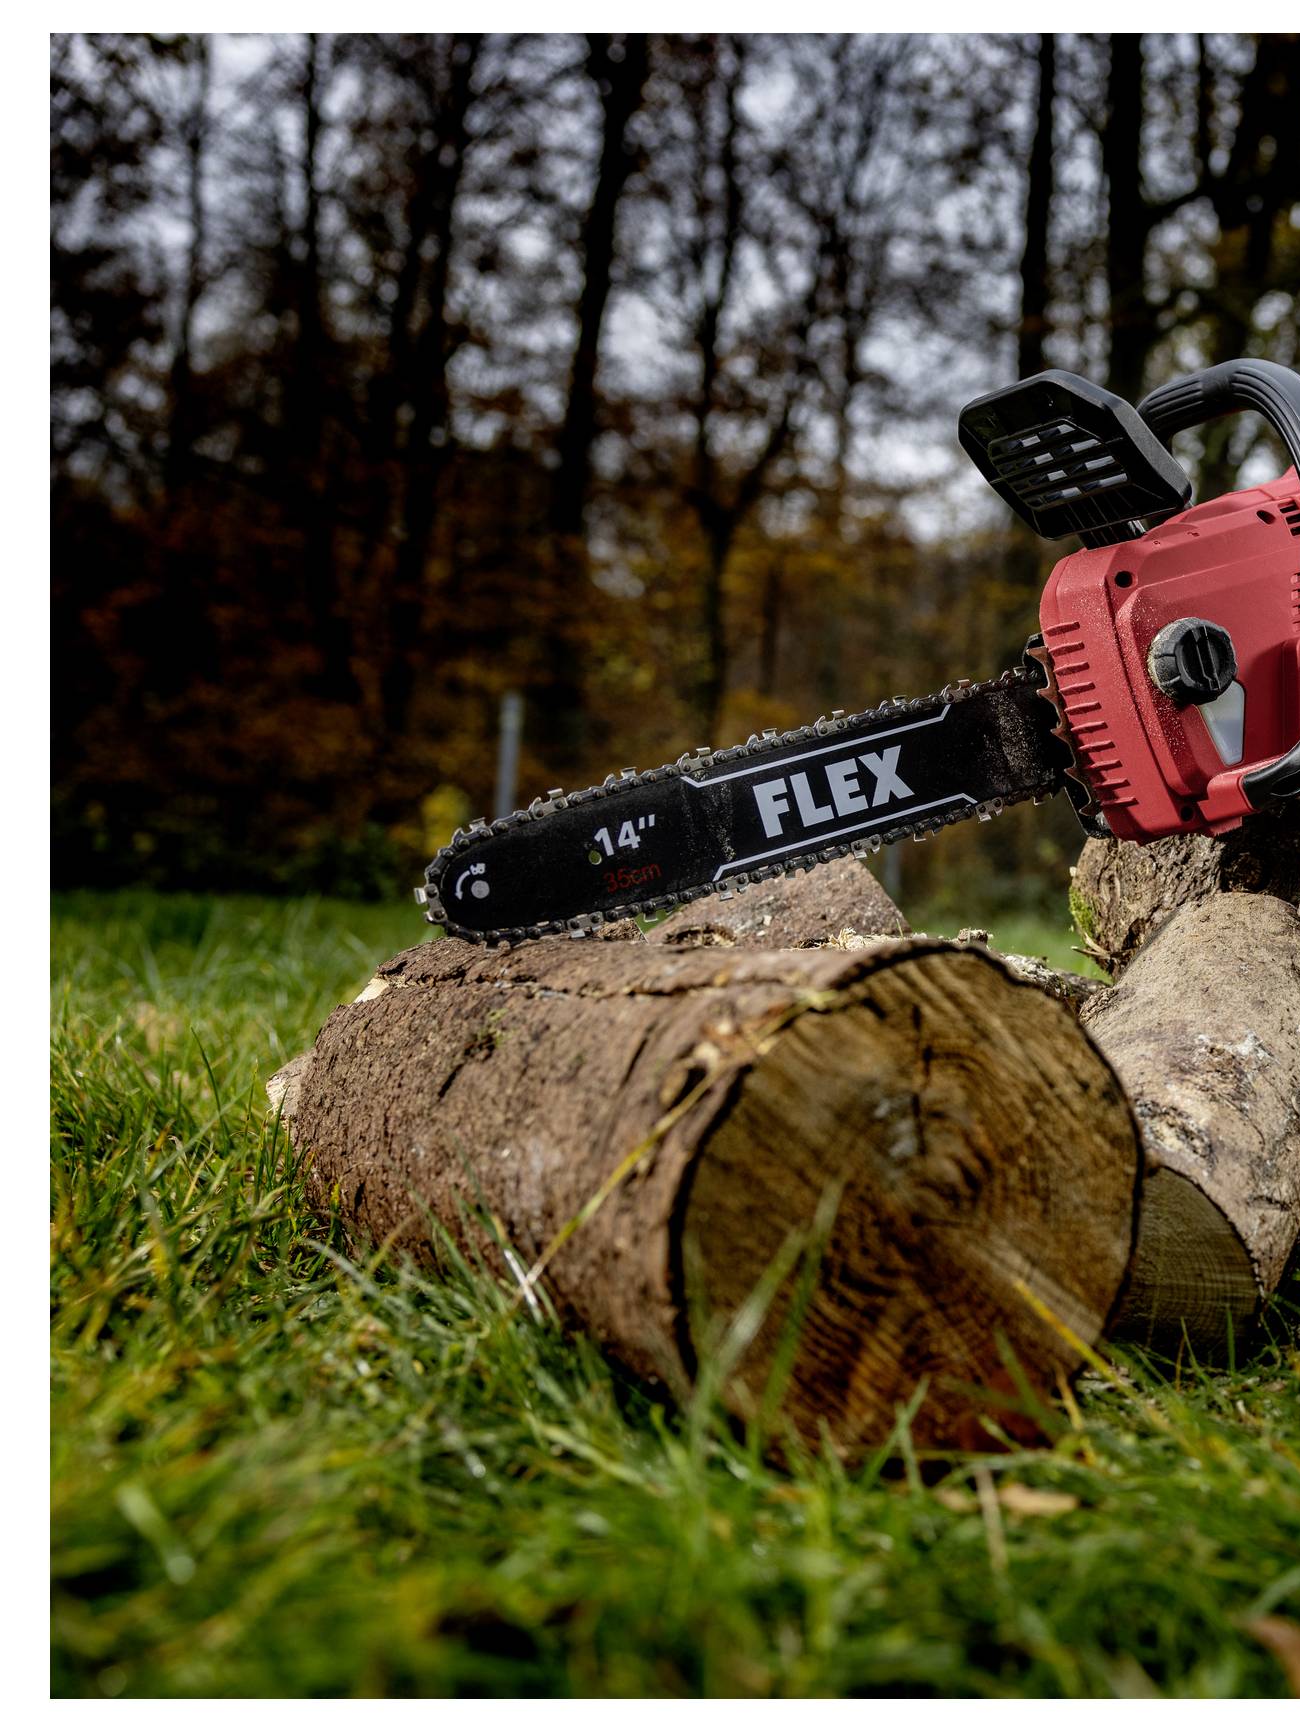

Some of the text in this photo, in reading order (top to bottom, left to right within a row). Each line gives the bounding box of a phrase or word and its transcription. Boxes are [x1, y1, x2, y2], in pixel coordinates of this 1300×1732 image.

[752, 745, 915, 838] FLEX
[594, 814, 655, 857] 14"
[603, 863, 662, 894] 35cm
